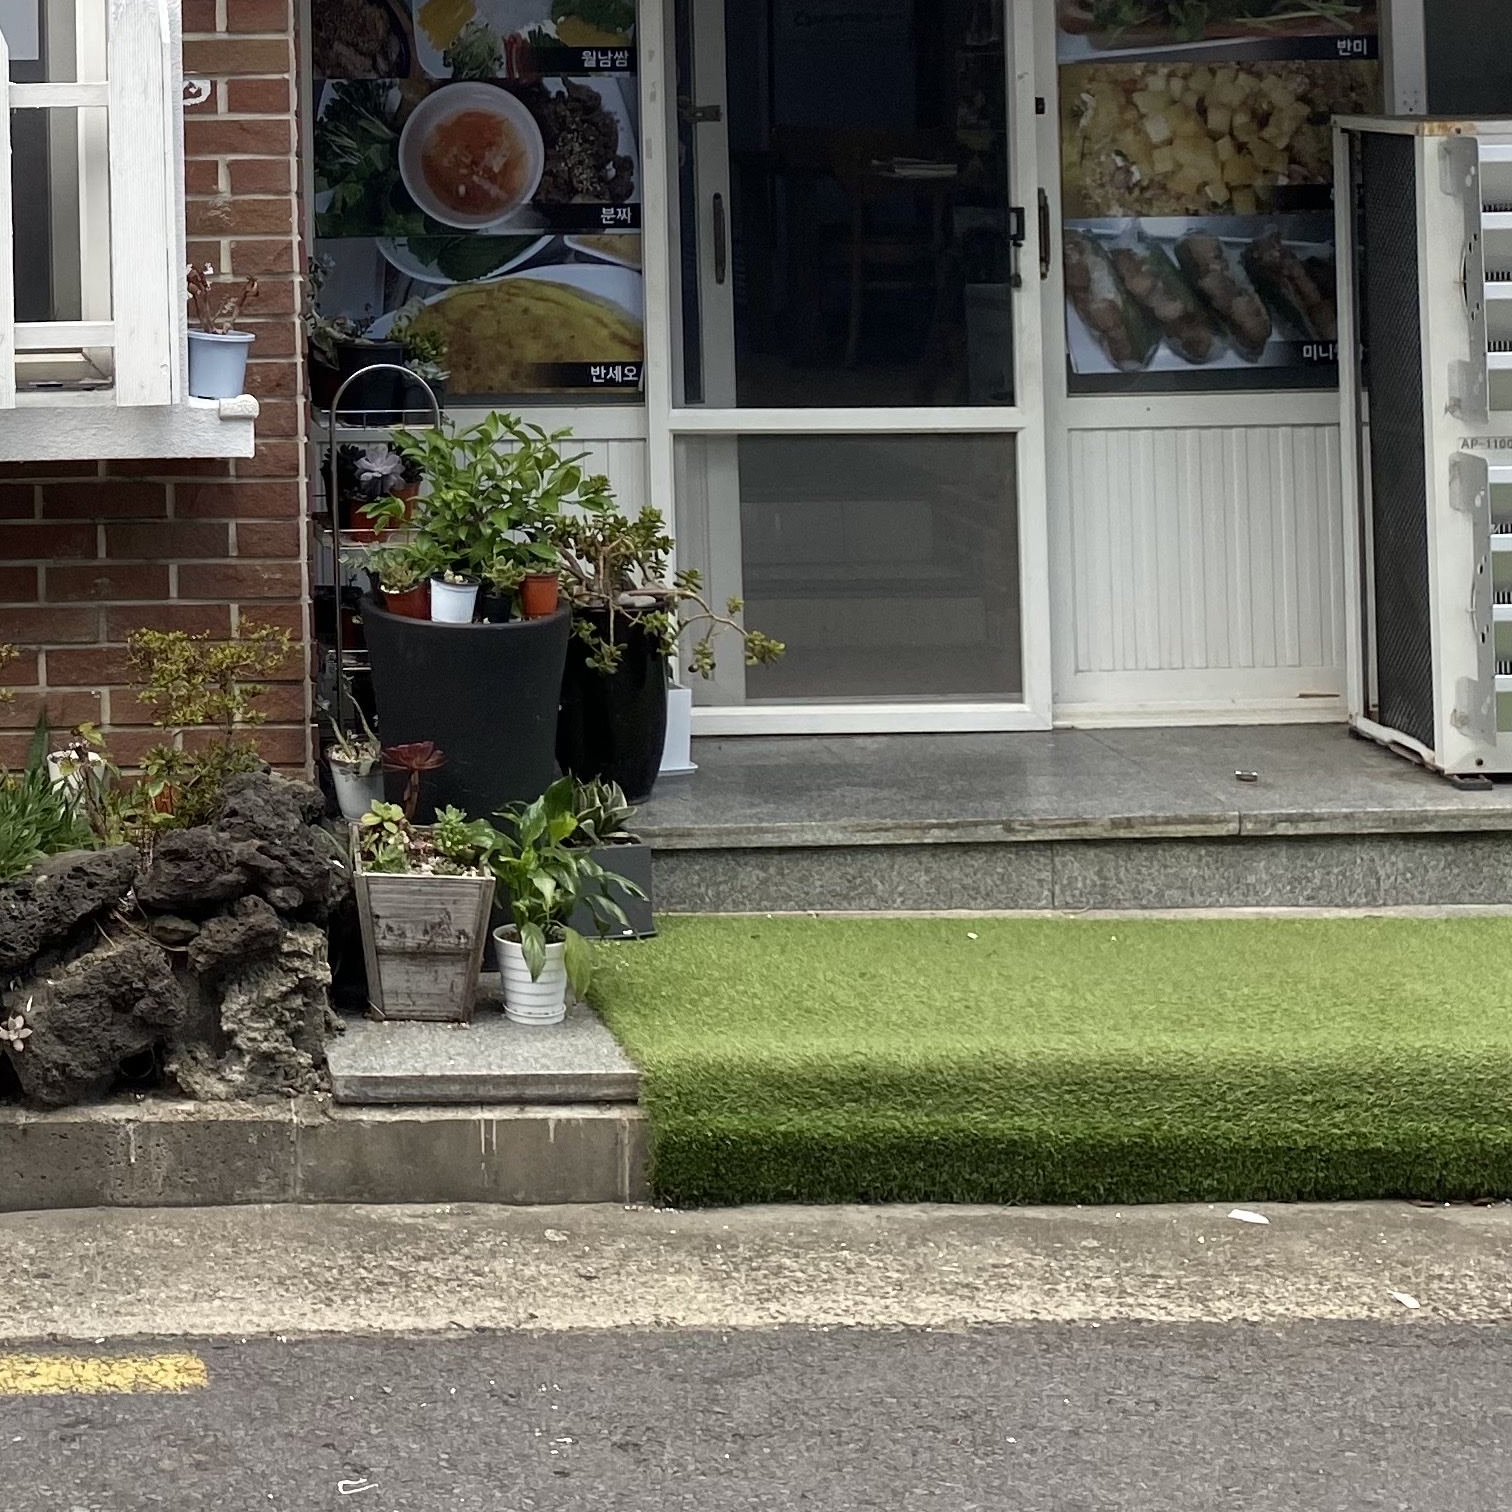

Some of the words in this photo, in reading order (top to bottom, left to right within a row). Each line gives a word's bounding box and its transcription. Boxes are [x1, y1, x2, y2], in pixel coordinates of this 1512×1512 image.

[1337, 38, 1367, 56] 반미
[581, 49, 629, 68] 월남쌈
[600, 207, 632, 224] 분짜
[590, 364, 639, 383] 반세오
